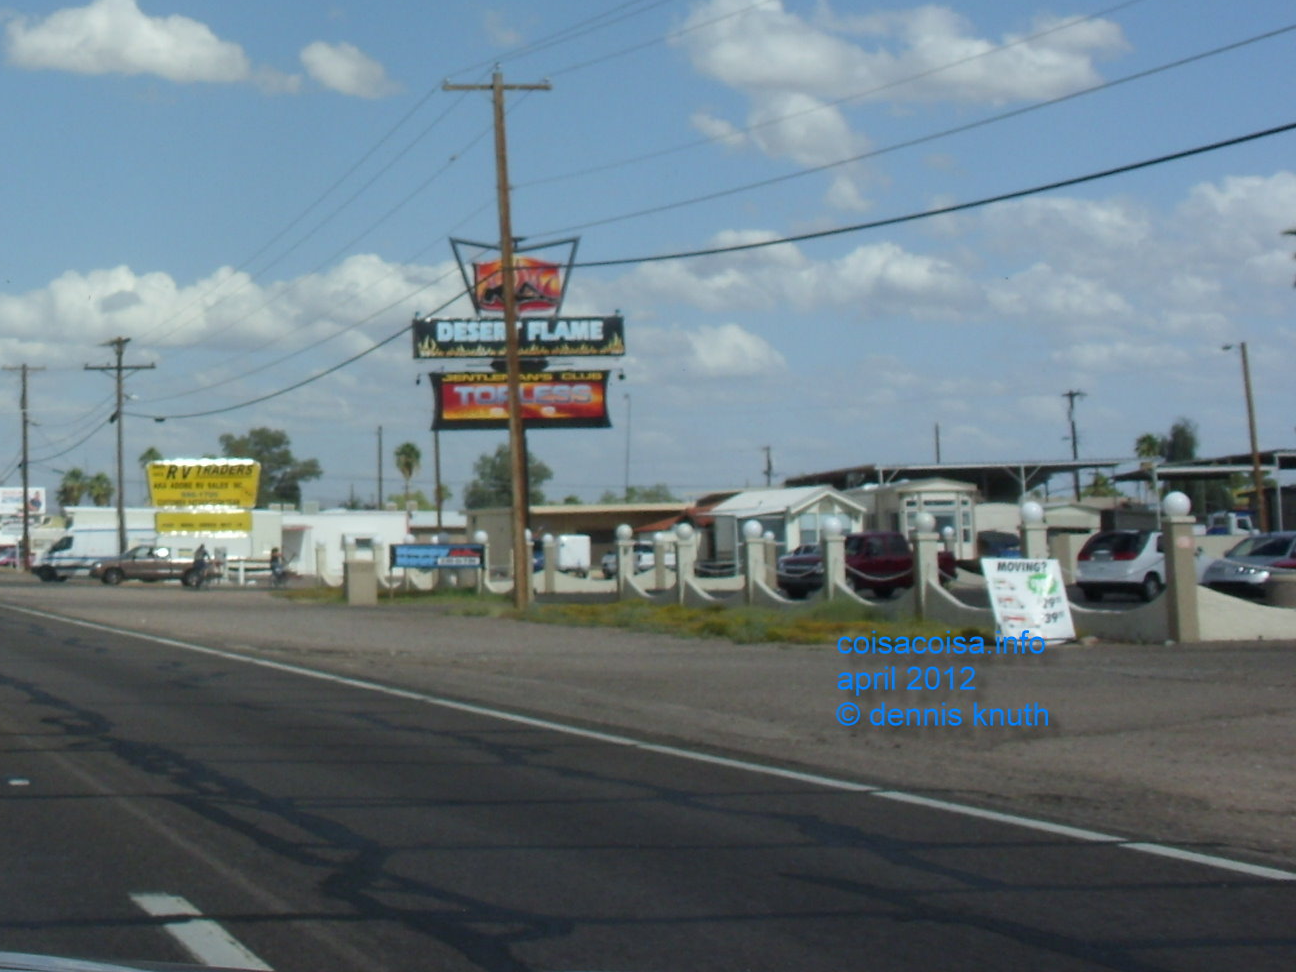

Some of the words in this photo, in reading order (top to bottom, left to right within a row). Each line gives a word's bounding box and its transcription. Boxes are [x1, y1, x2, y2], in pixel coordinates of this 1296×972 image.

[527, 320, 604, 341] FLAME
[442, 373, 553, 382] GENTLEAN'S
[561, 372, 603, 381] CLUB
[196, 464, 253, 476] TRADERS
[996, 561, 1048, 573] MOVING?
